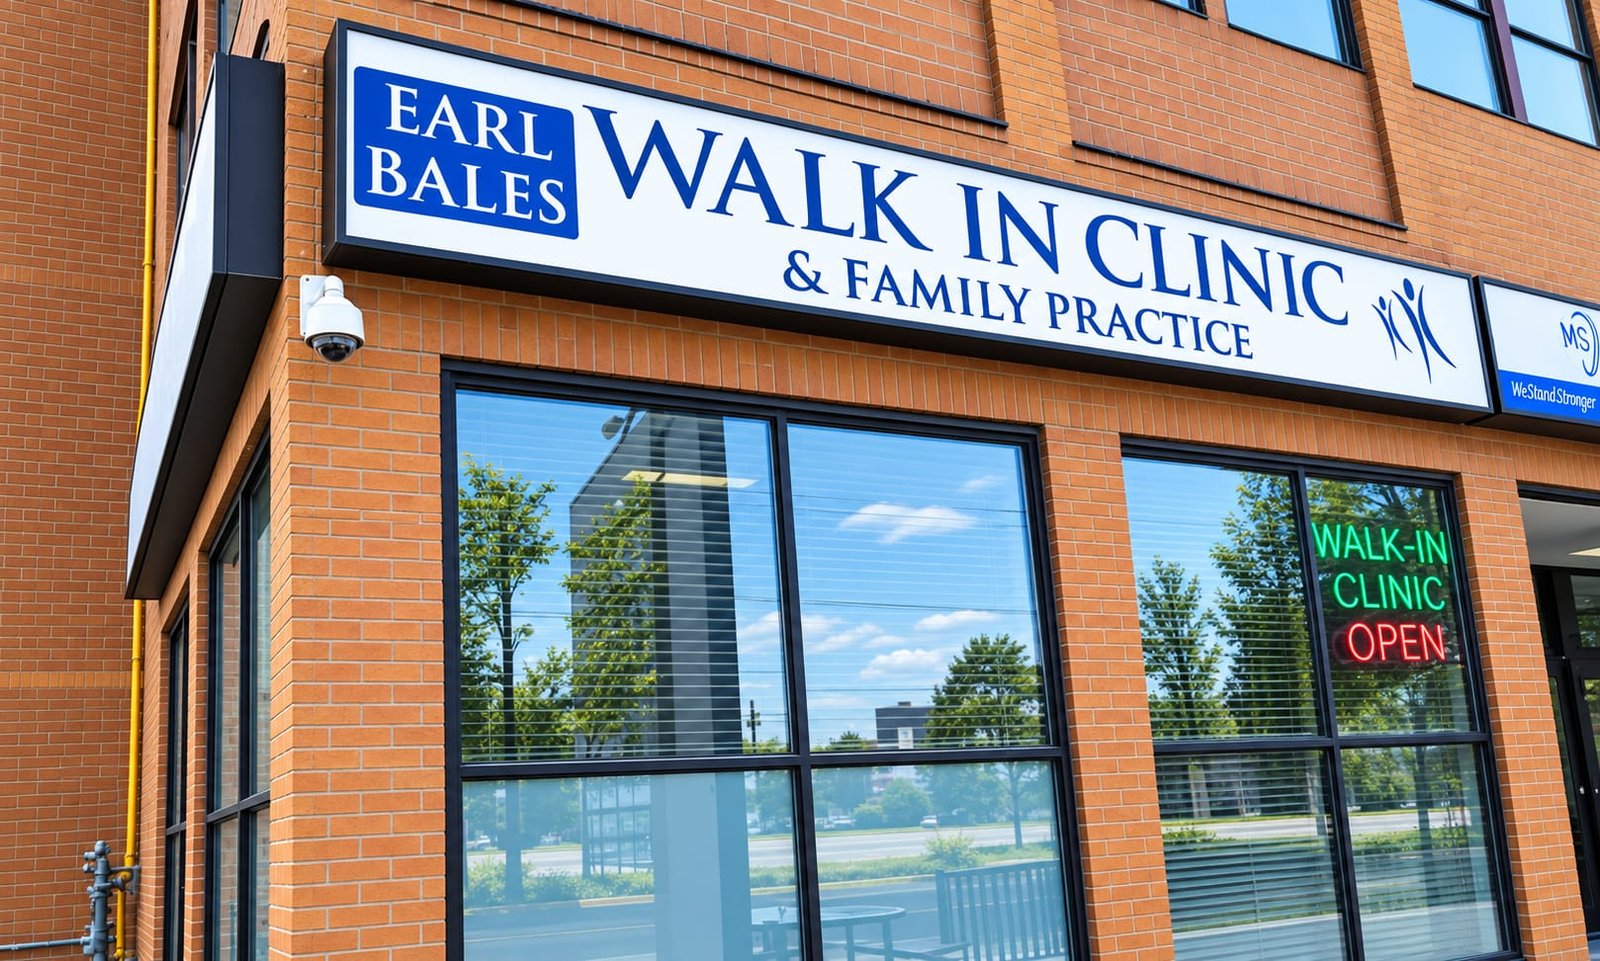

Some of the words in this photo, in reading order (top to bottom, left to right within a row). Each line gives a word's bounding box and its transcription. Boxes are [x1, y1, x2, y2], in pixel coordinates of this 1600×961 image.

[385, 83, 554, 162] EARL
[366, 145, 567, 226] BALES
[582, 105, 934, 252] WALK
[957, 183, 1059, 274] IN
[1085, 214, 1350, 327] CLINIC
[783, 249, 828, 294] &
[844, 258, 1030, 324] FAMILY
[1046, 292, 1253, 360] PRACTICE
[1556, 388, 1597, 413] Stronger
[1311, 521, 1449, 565] WALK-IN
[1333, 572, 1446, 611] CLINIC
[1347, 622, 1446, 662] OPEN
